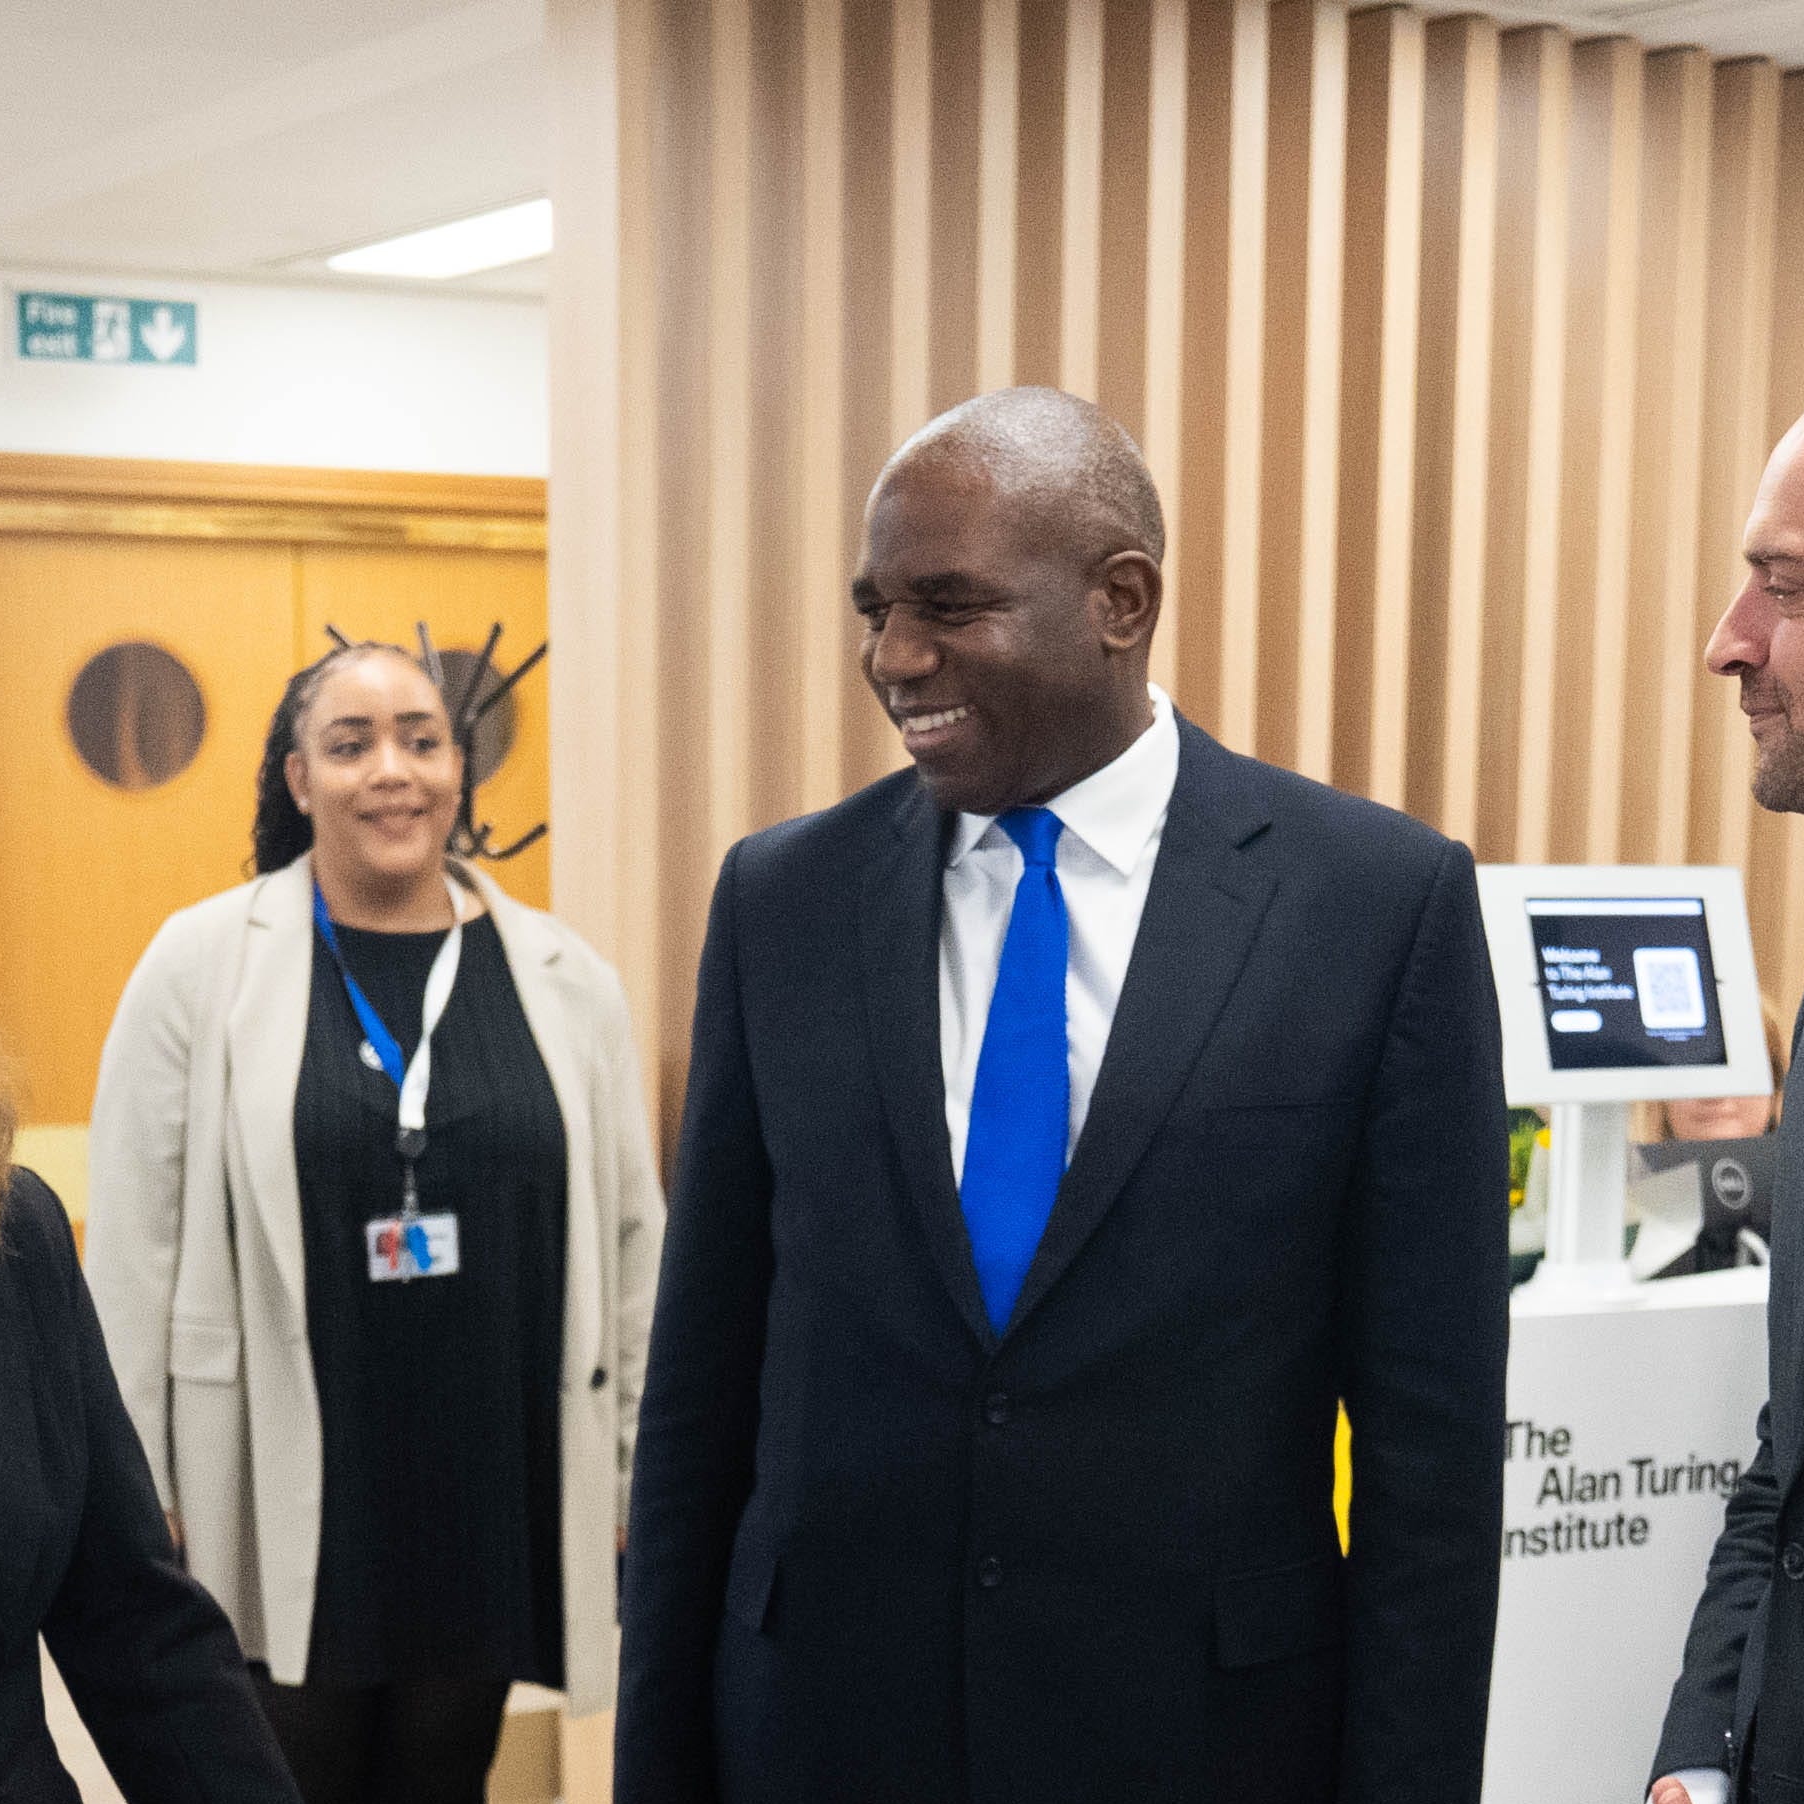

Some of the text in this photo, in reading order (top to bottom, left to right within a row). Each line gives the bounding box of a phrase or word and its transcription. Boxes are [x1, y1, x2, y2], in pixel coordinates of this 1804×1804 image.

[1505, 1420, 1572, 1459] The
[1536, 1453, 1741, 1507] Alan Turing
[1504, 1512, 1649, 1557] nstitute
